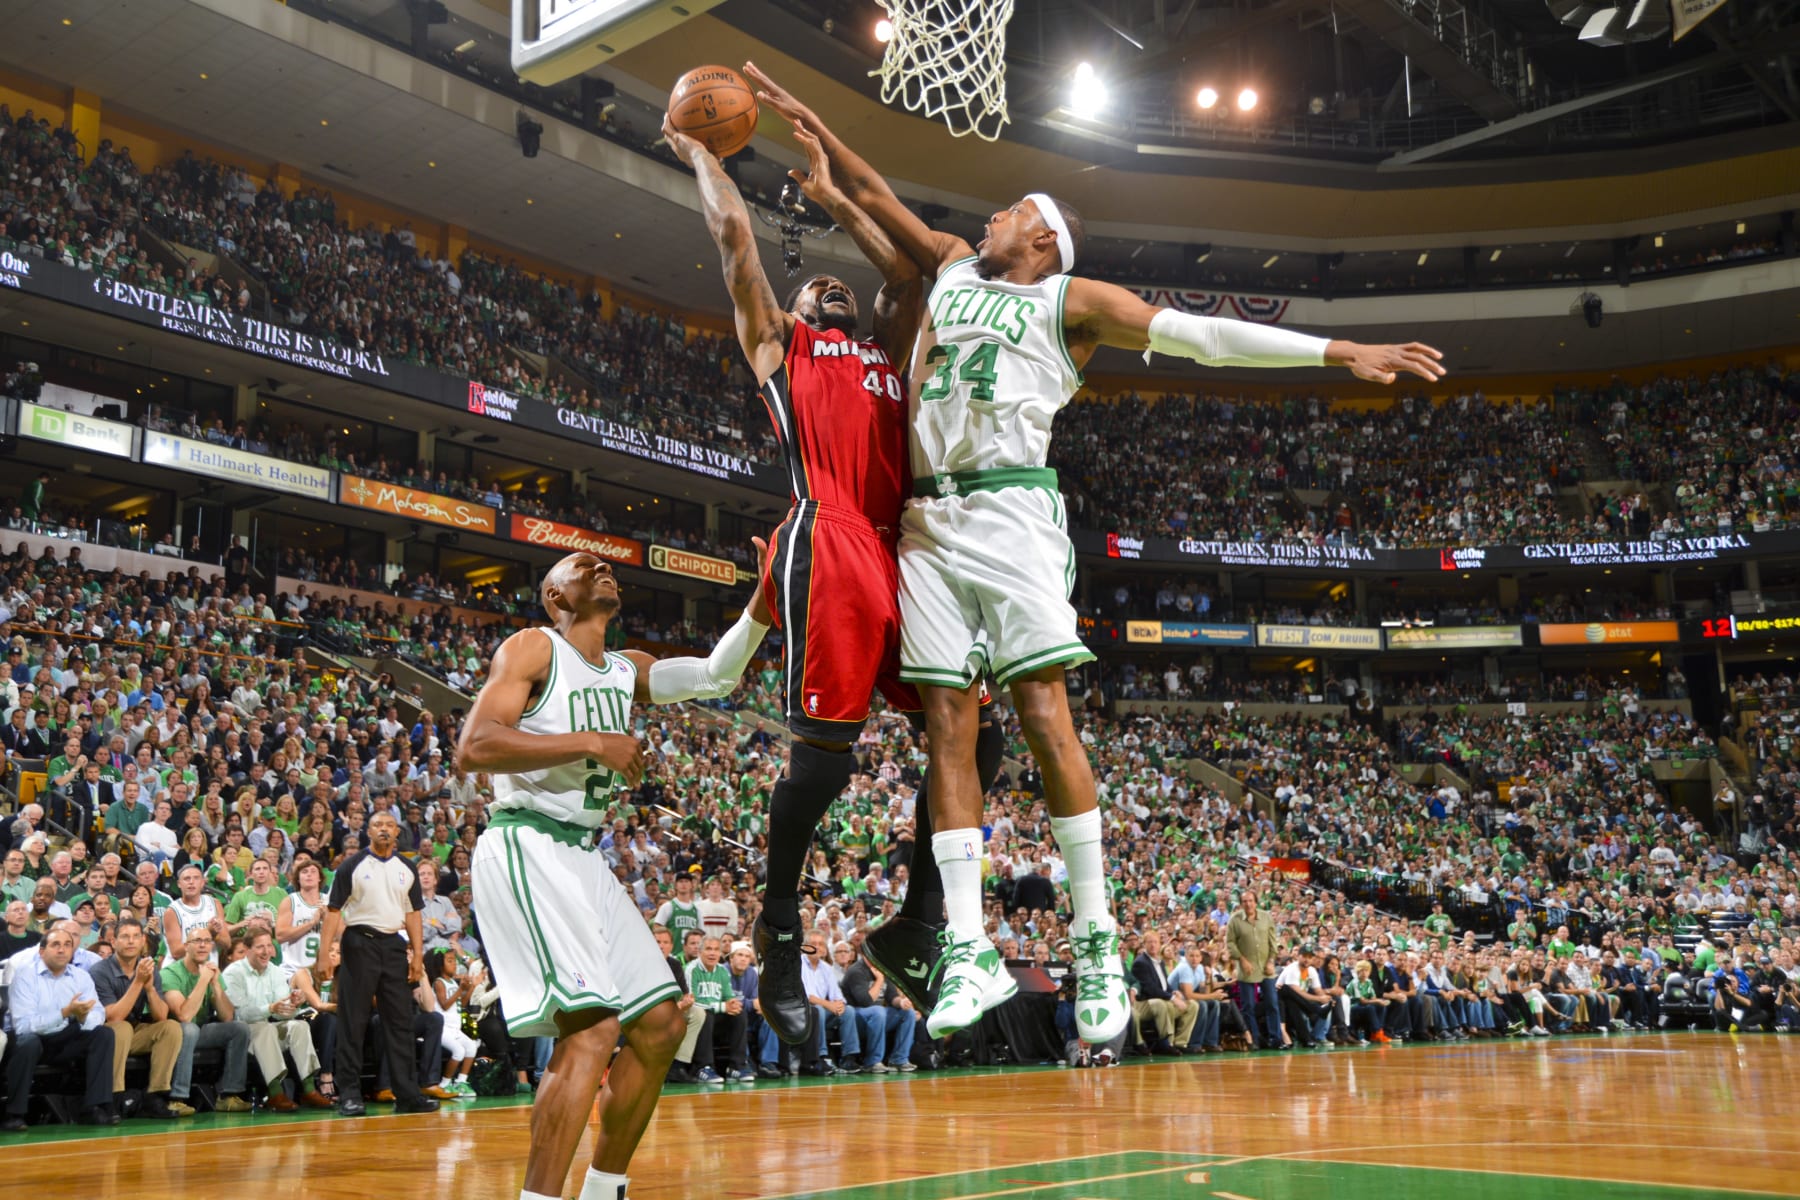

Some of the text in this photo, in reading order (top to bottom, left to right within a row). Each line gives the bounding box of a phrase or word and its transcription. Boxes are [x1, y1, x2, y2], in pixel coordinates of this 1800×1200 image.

[687, 72, 735, 88] ALDING
[927, 287, 1036, 346] CELTICS
[242, 317, 291, 347] THIS
[295, 331, 313, 353] IS
[862, 370, 902, 402] 40
[919, 341, 999, 402] 34
[36, 412, 121, 443] TD Bank
[655, 435, 688, 457] THIS
[690, 444, 703, 461] IS
[189, 447, 263, 476] Hallmark
[268, 466, 319, 489] Health
[376, 487, 489, 526] Mohegan Sun
[523, 517, 633, 559] Budweiser
[1271, 543, 1304, 557] THIS
[1307, 545, 1320, 558] IS
[1626, 540, 1663, 554] THIS
[1666, 540, 1683, 553] IS
[669, 555, 732, 579] CHIPOTLE
[1701, 618, 1731, 637] 12
[568, 687, 634, 733] CELTIC
